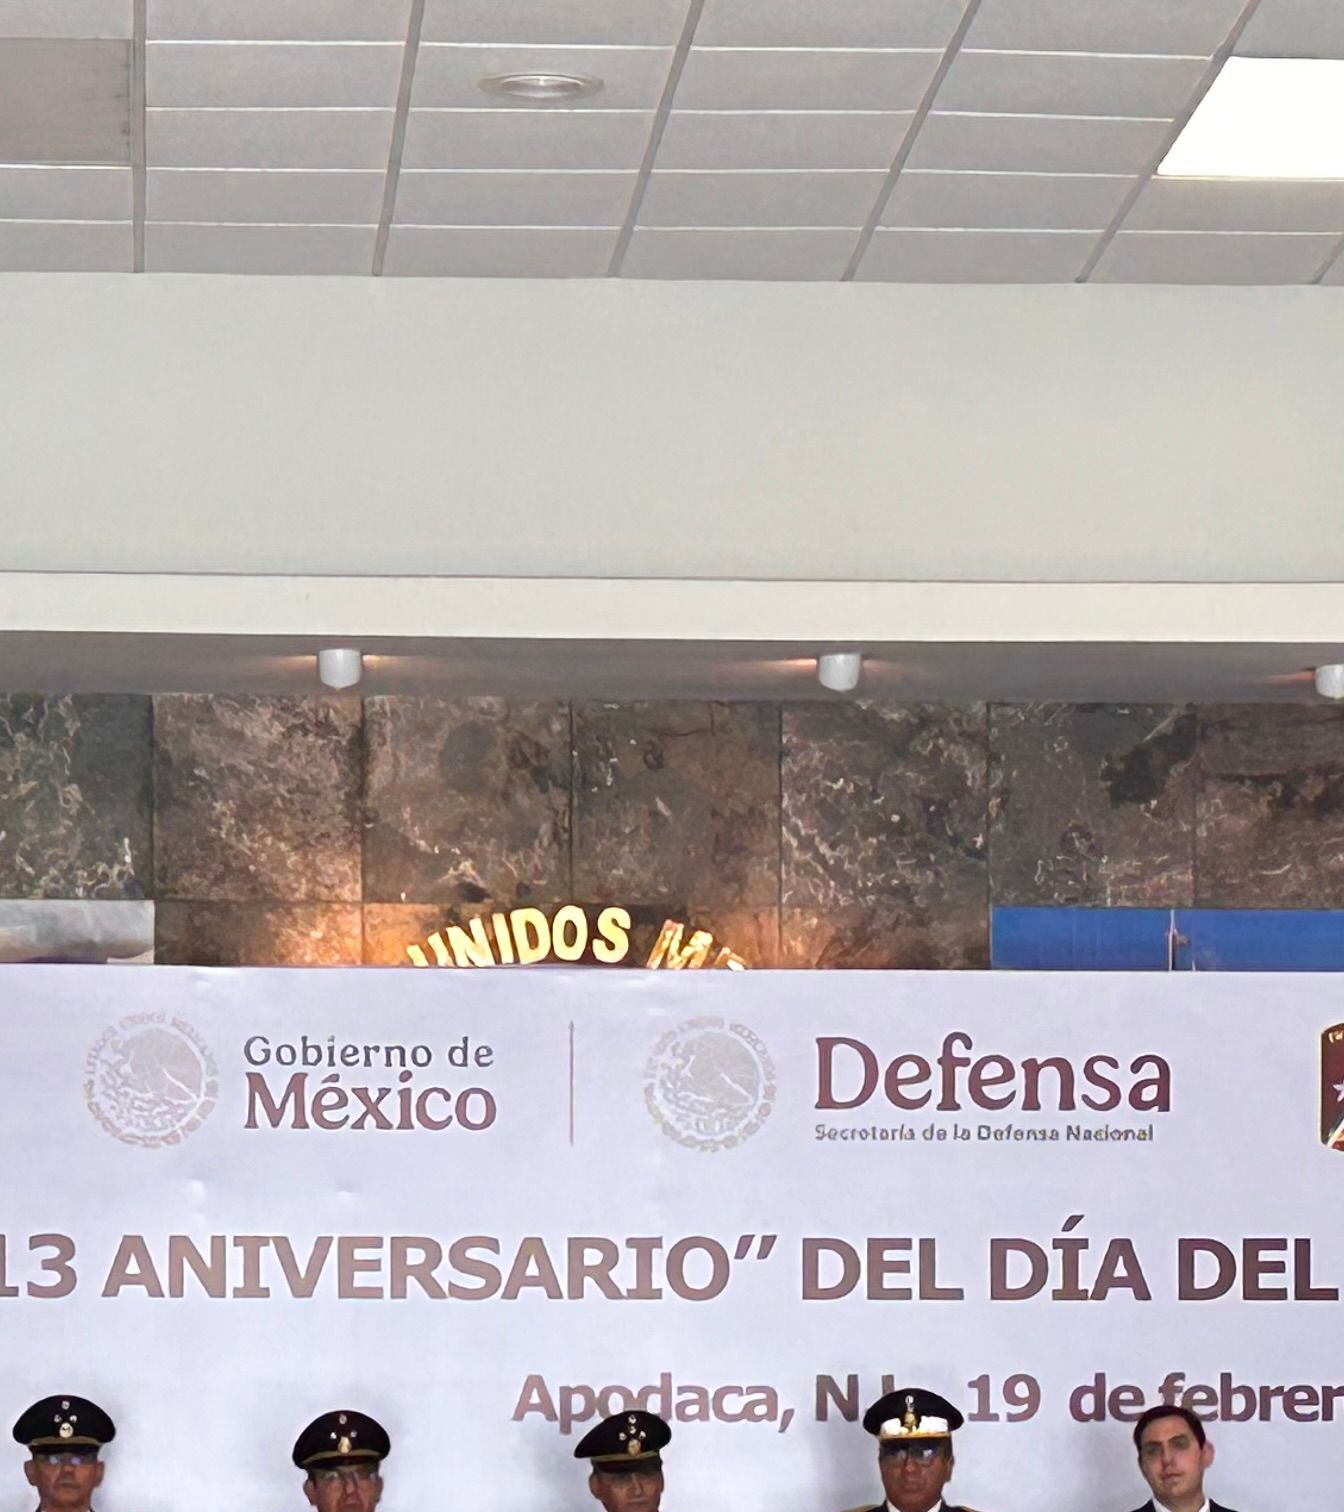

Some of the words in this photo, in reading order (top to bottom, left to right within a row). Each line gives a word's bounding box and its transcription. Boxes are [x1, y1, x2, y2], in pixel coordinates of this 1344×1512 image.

[244, 1035, 433, 1068] Gobierno
[447, 1036, 495, 1067] de
[814, 1031, 1171, 1113] Defensa
[244, 1070, 497, 1132] México
[922, 1122, 947, 1142] de
[953, 1123, 970, 1142] la
[977, 1123, 1060, 1142] Defensa
[1066, 1123, 1153, 1142] Nacional
[802, 1237, 965, 1301] DEL
[990, 1215, 1153, 1302] DÍA
[1178, 1237, 1340, 1302] DEL
[512, 1371, 795, 1435] Apodaca,
[967, 1373, 1042, 1423] 19
[1069, 1371, 1145, 1423] de
